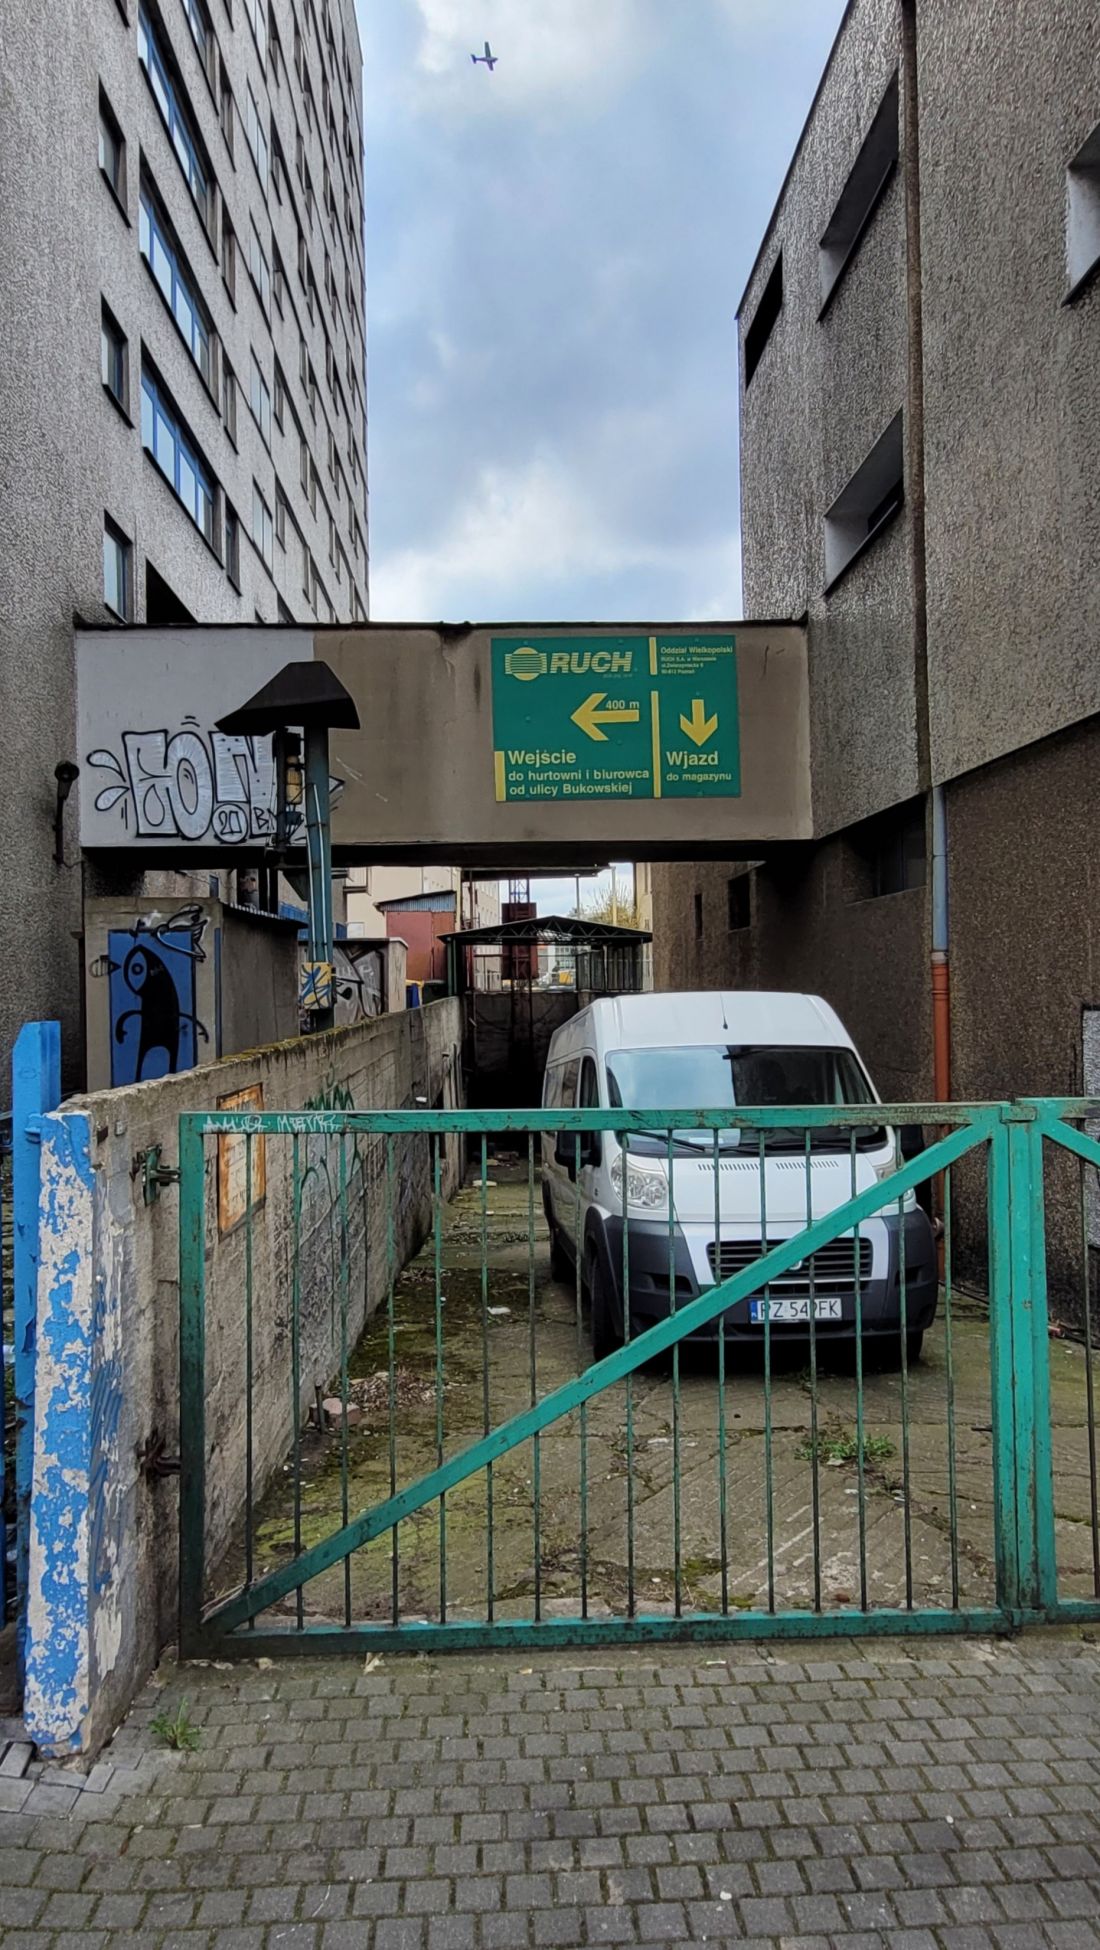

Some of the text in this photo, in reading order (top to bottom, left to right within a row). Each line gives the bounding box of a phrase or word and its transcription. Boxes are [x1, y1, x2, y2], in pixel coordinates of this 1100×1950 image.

[550, 651, 633, 673] RUCH
[606, 700, 639, 709] 400 m
[508, 749, 577, 768] Wejście
[666, 751, 719, 769] Wjazd
[508, 771, 524, 781] do
[528, 769, 581, 780] hurtowni
[593, 769, 649, 780] biurowca
[666, 771, 731, 782] do magazynu
[510, 782, 632, 797] od ulicy Bukowskiej
